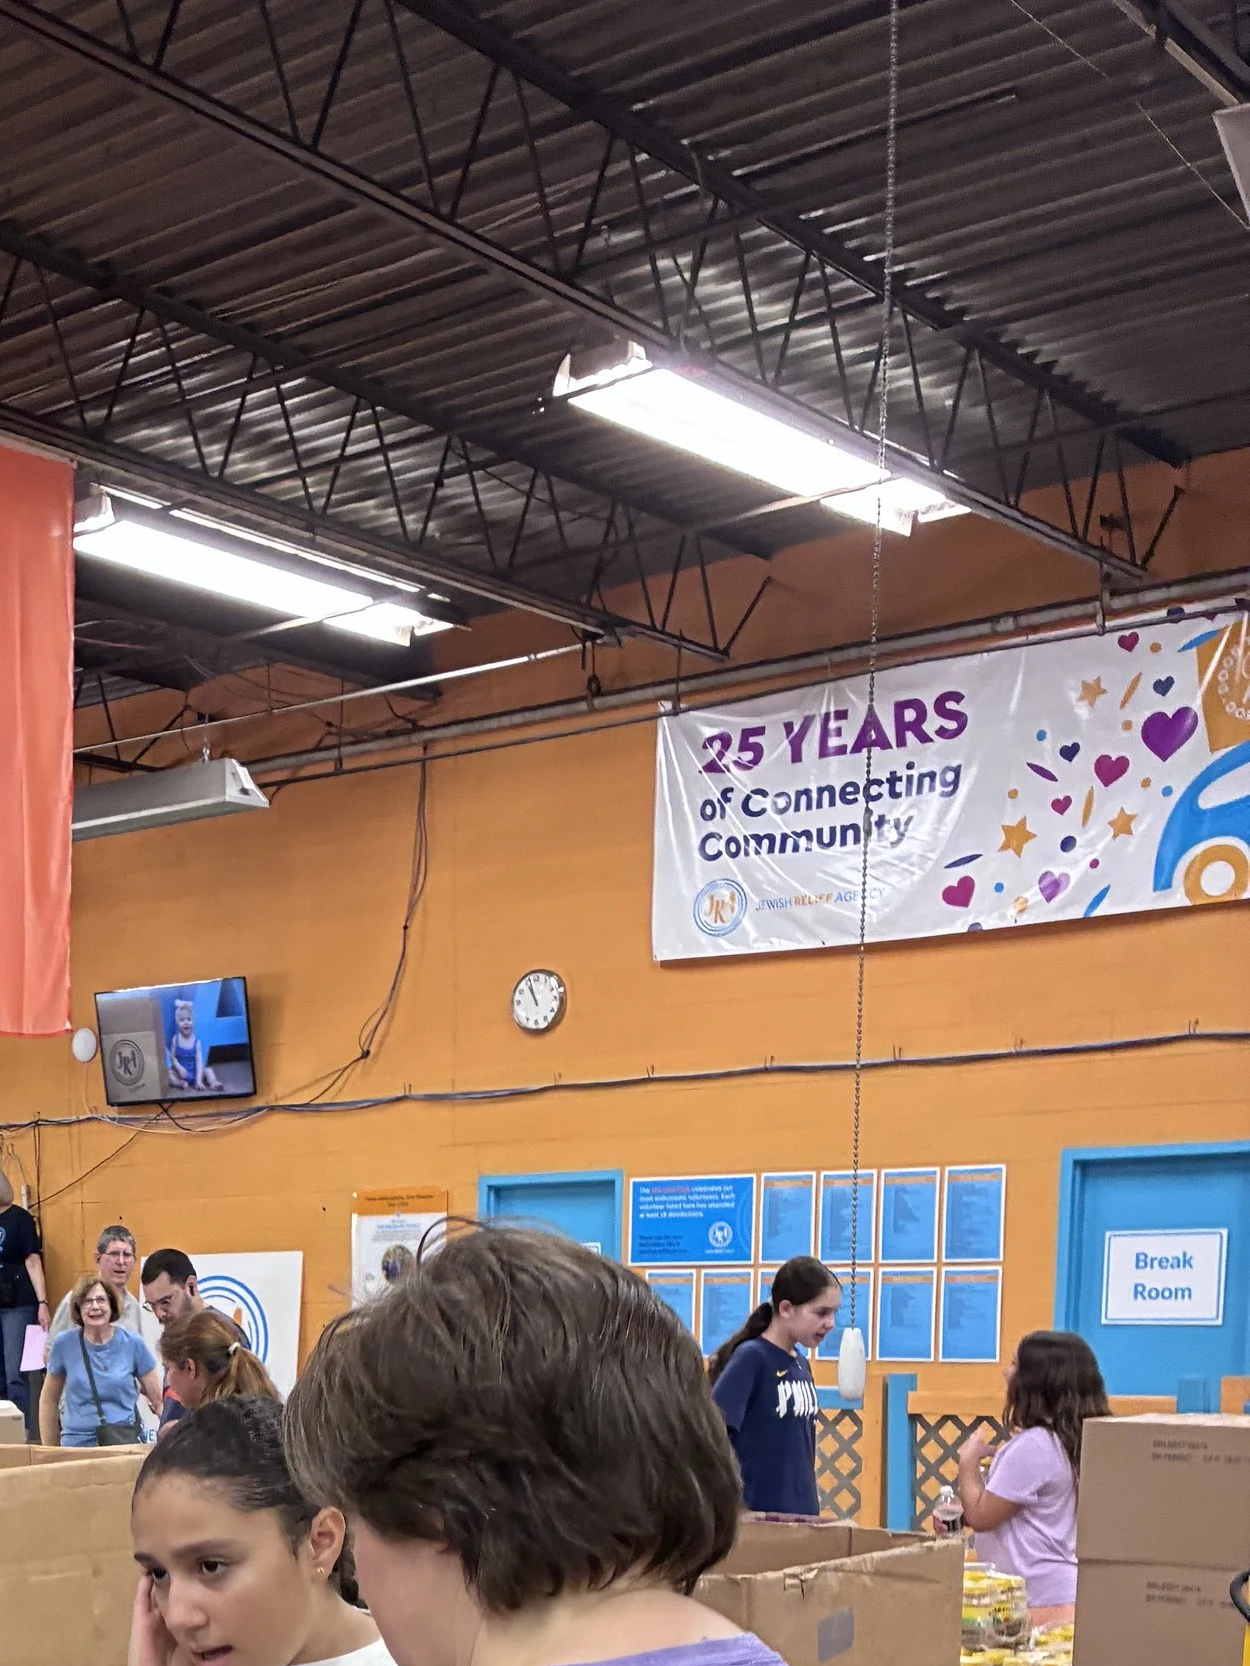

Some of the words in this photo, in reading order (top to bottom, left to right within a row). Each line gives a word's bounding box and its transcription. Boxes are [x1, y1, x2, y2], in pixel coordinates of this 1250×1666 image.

[700, 726, 766, 774] 25
[783, 691, 969, 764] YEARS
[700, 787, 734, 821] of
[741, 761, 962, 817] Connecting
[834, 887, 886, 903] AGECY
[1135, 1251, 1194, 1271] Break
[1133, 1282, 1192, 1301] Room
